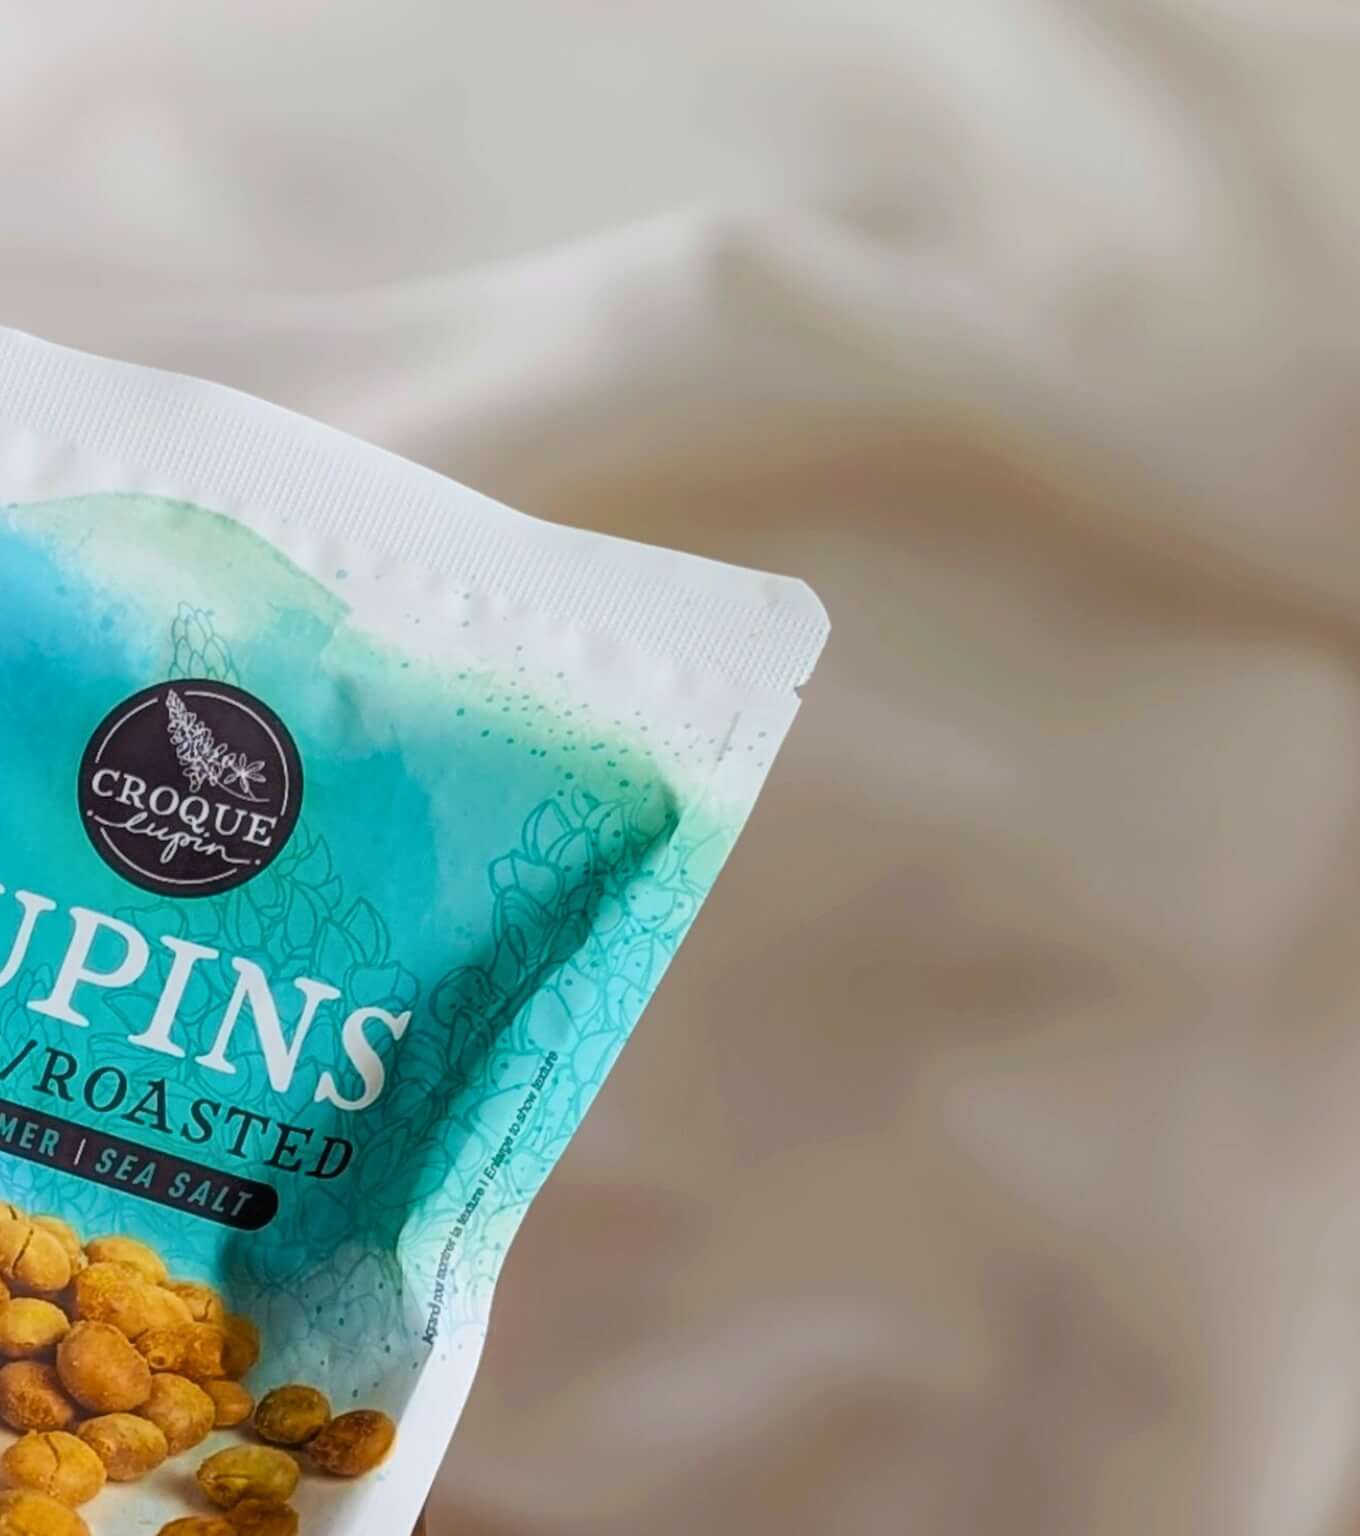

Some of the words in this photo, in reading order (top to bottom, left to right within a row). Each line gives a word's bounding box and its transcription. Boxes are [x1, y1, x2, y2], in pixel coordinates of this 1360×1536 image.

[91, 768, 278, 847] CROQUE
[94, 812, 251, 864] lupin
[516, 1091, 537, 1124] show
[94, 1149, 156, 1190] SEA
[167, 1171, 253, 1219] SALT
